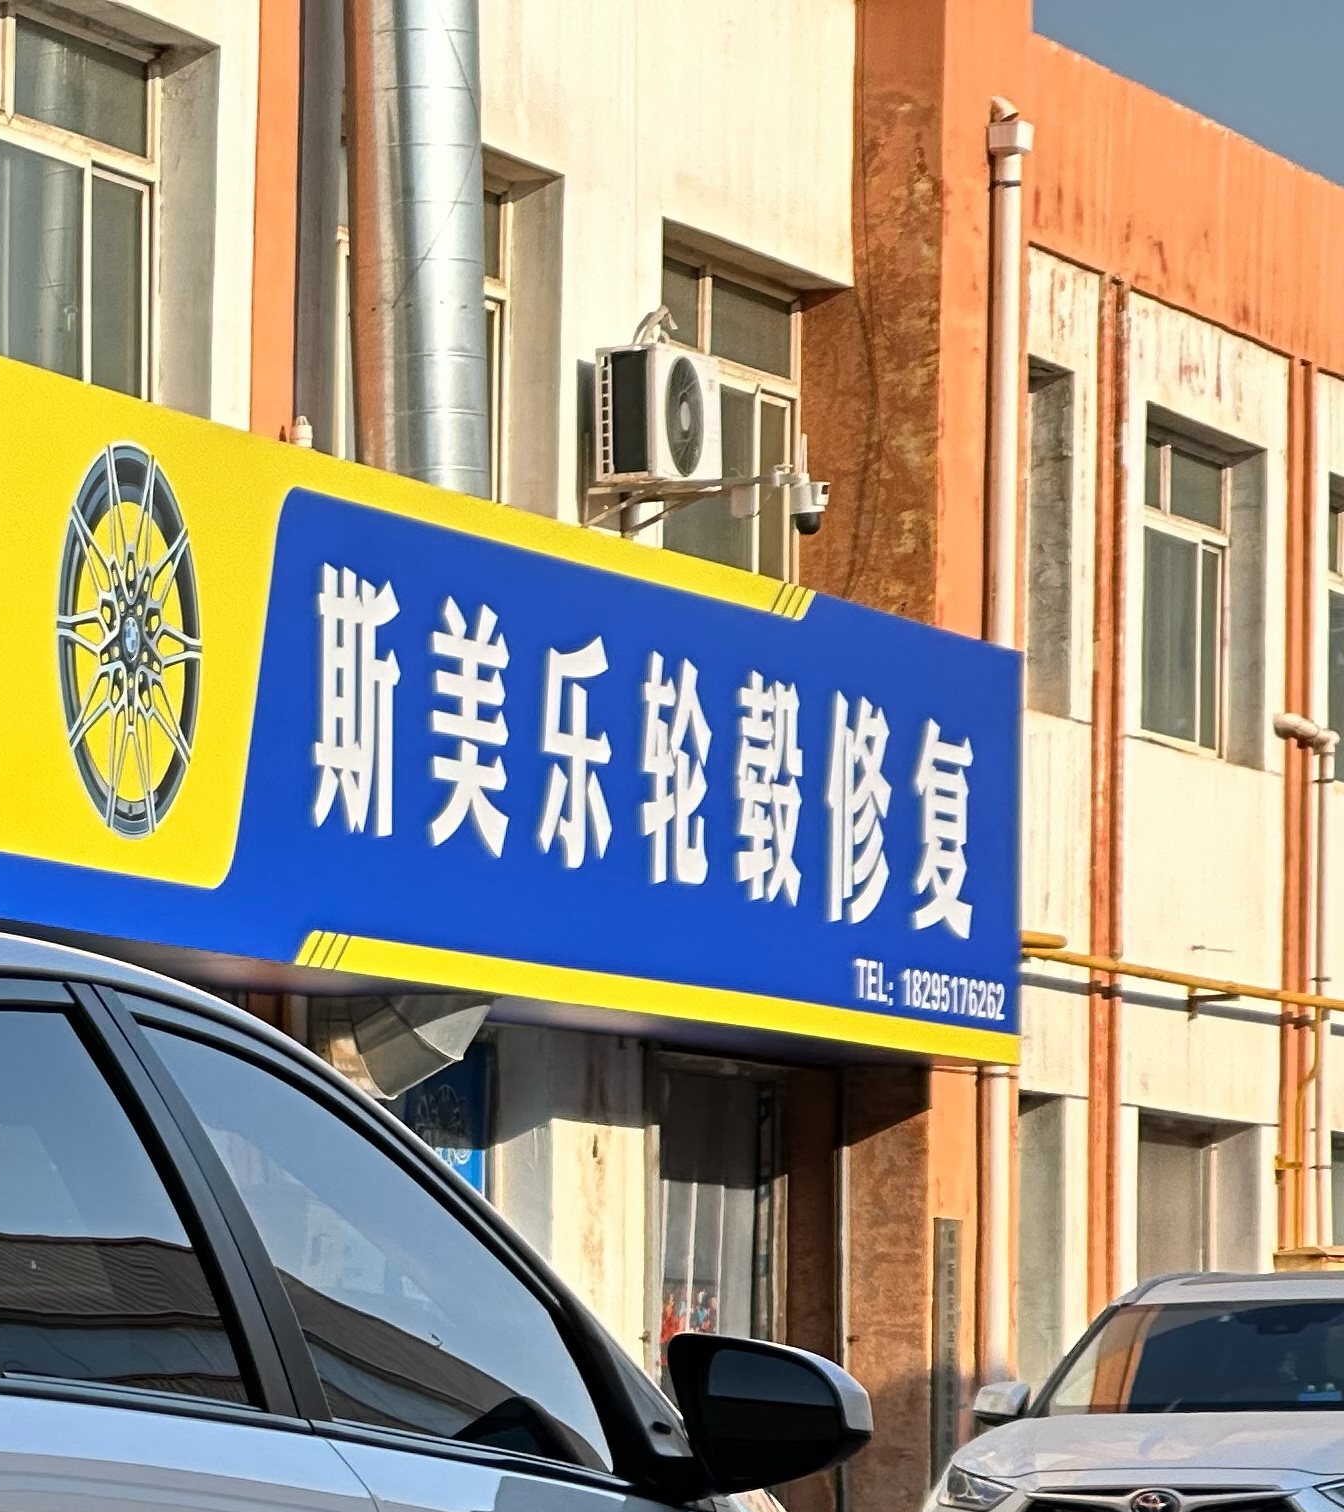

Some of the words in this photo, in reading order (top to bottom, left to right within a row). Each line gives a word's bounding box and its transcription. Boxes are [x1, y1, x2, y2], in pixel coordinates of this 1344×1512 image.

[313, 561, 975, 940] 斯美乐轮毂修复
[853, 958, 894, 1007] TEL:
[902, 968, 1006, 1021] 18295176262
